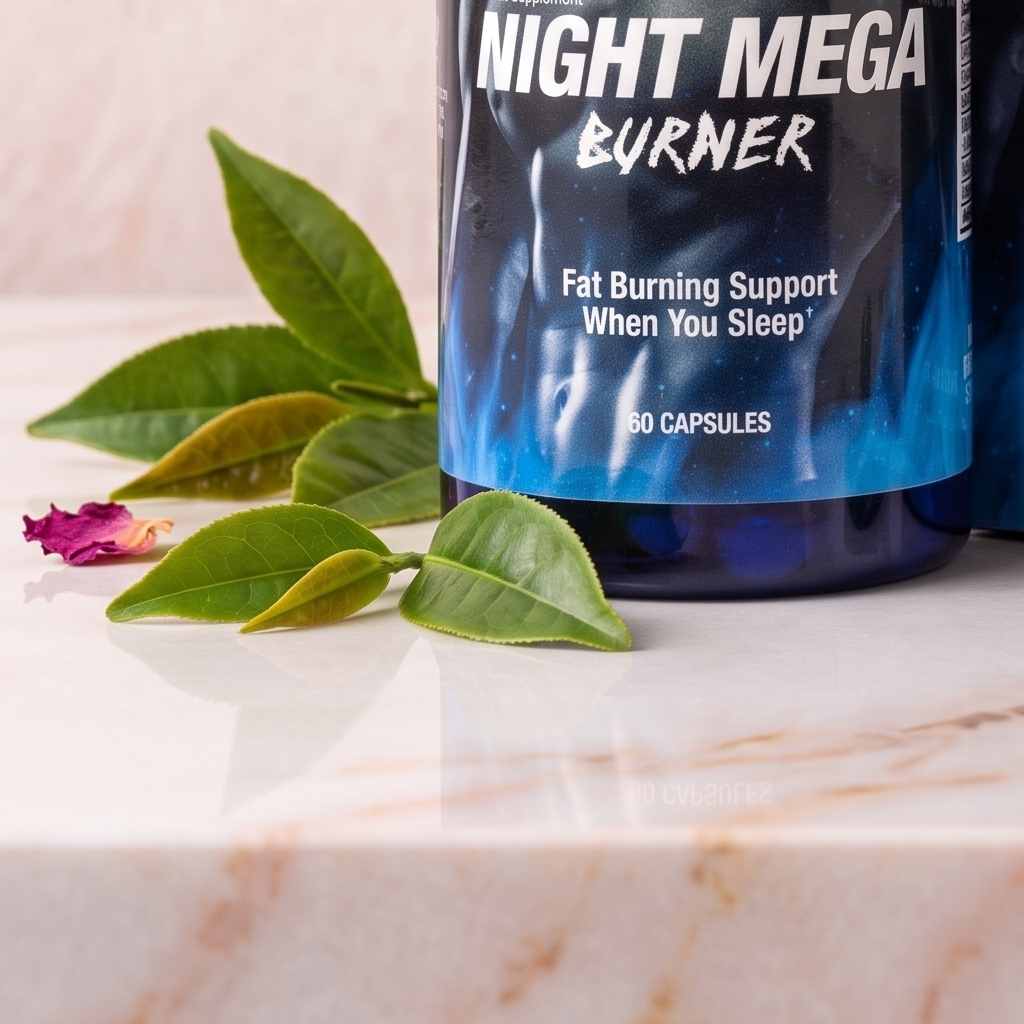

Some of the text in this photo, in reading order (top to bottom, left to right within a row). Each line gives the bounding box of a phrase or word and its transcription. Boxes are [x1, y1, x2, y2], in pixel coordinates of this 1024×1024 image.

[475, 8, 927, 100] NIGHT MEGA
[576, 111, 813, 175] BURNER
[562, 268, 838, 306] Fat Burning Support
[583, 306, 659, 338] When
[667, 307, 719, 338] You
[627, 411, 772, 436] 60 CAPSULES
